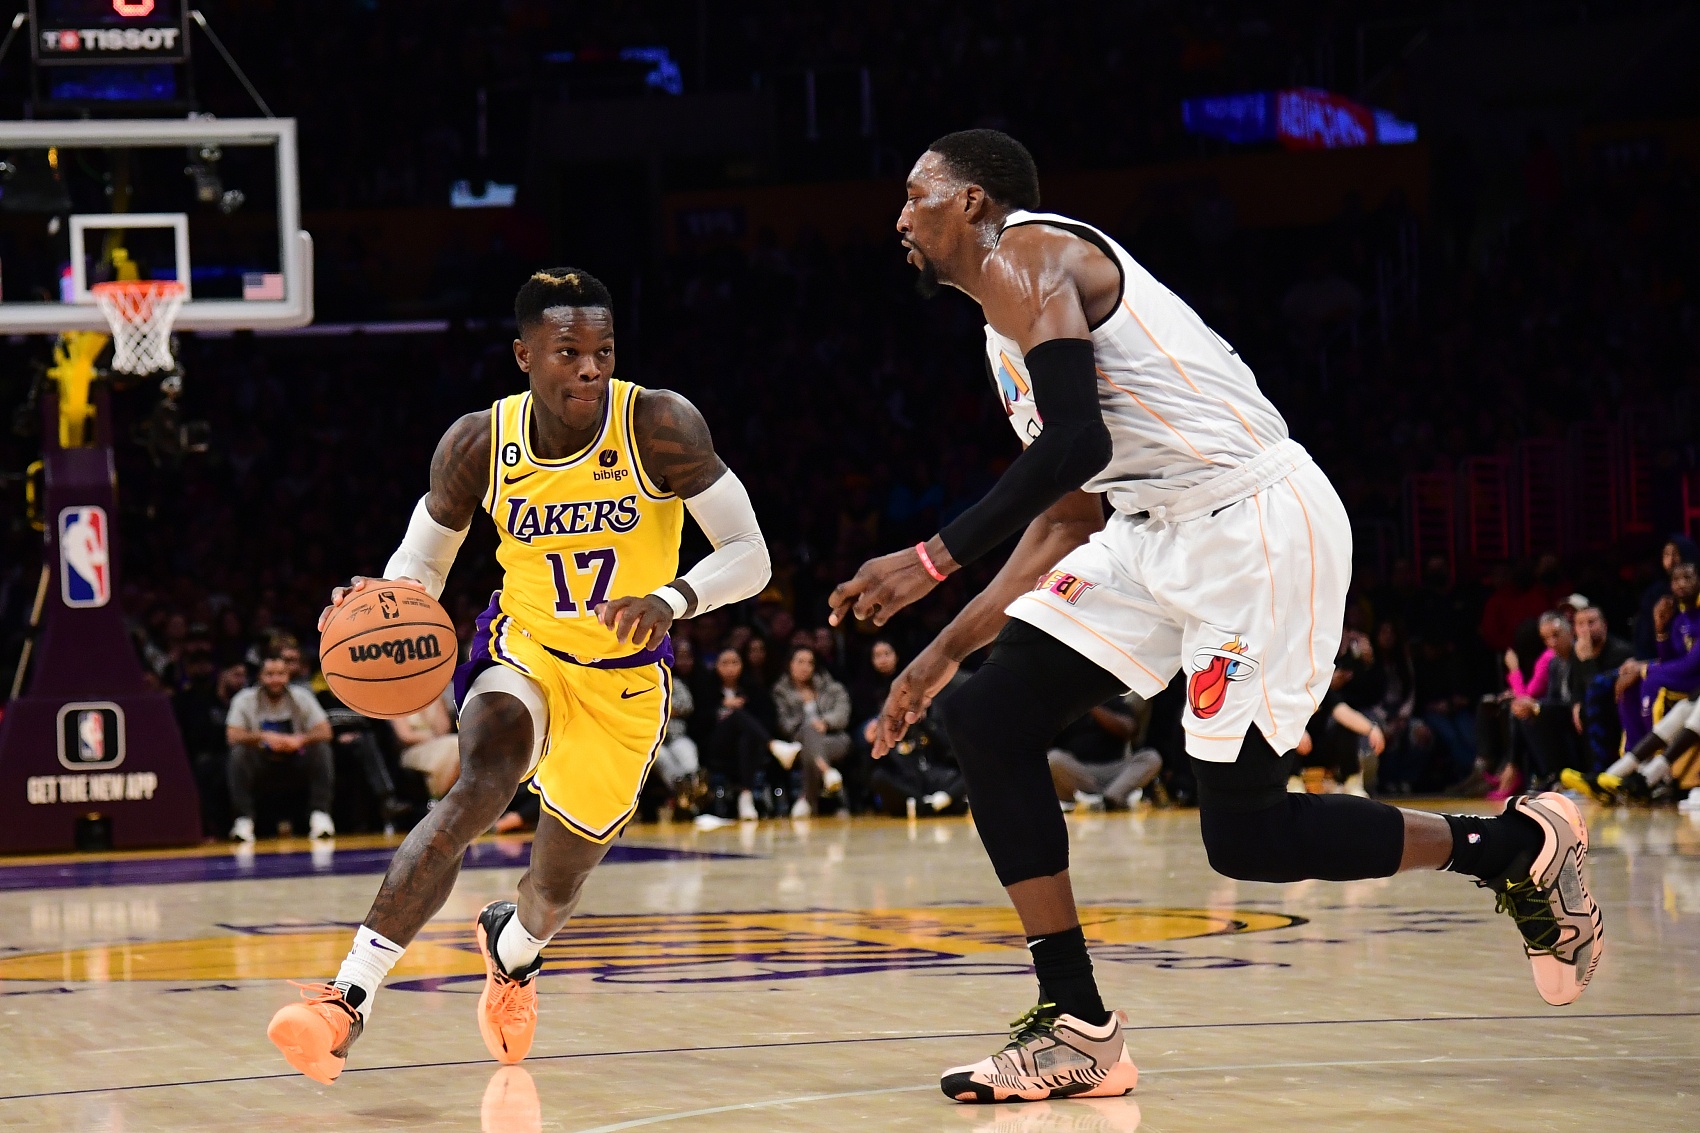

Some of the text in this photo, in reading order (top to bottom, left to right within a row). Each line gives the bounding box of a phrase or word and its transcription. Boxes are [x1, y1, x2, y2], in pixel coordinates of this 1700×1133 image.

[80, 28, 180, 50] TISSOT
[506, 445, 517, 465] 6
[593, 468, 629, 481] bibigo
[506, 494, 642, 544] LAKERS
[545, 547, 620, 618] 17
[348, 633, 442, 665] Wilson
[26, 771, 159, 805] GET THE NEW APP
